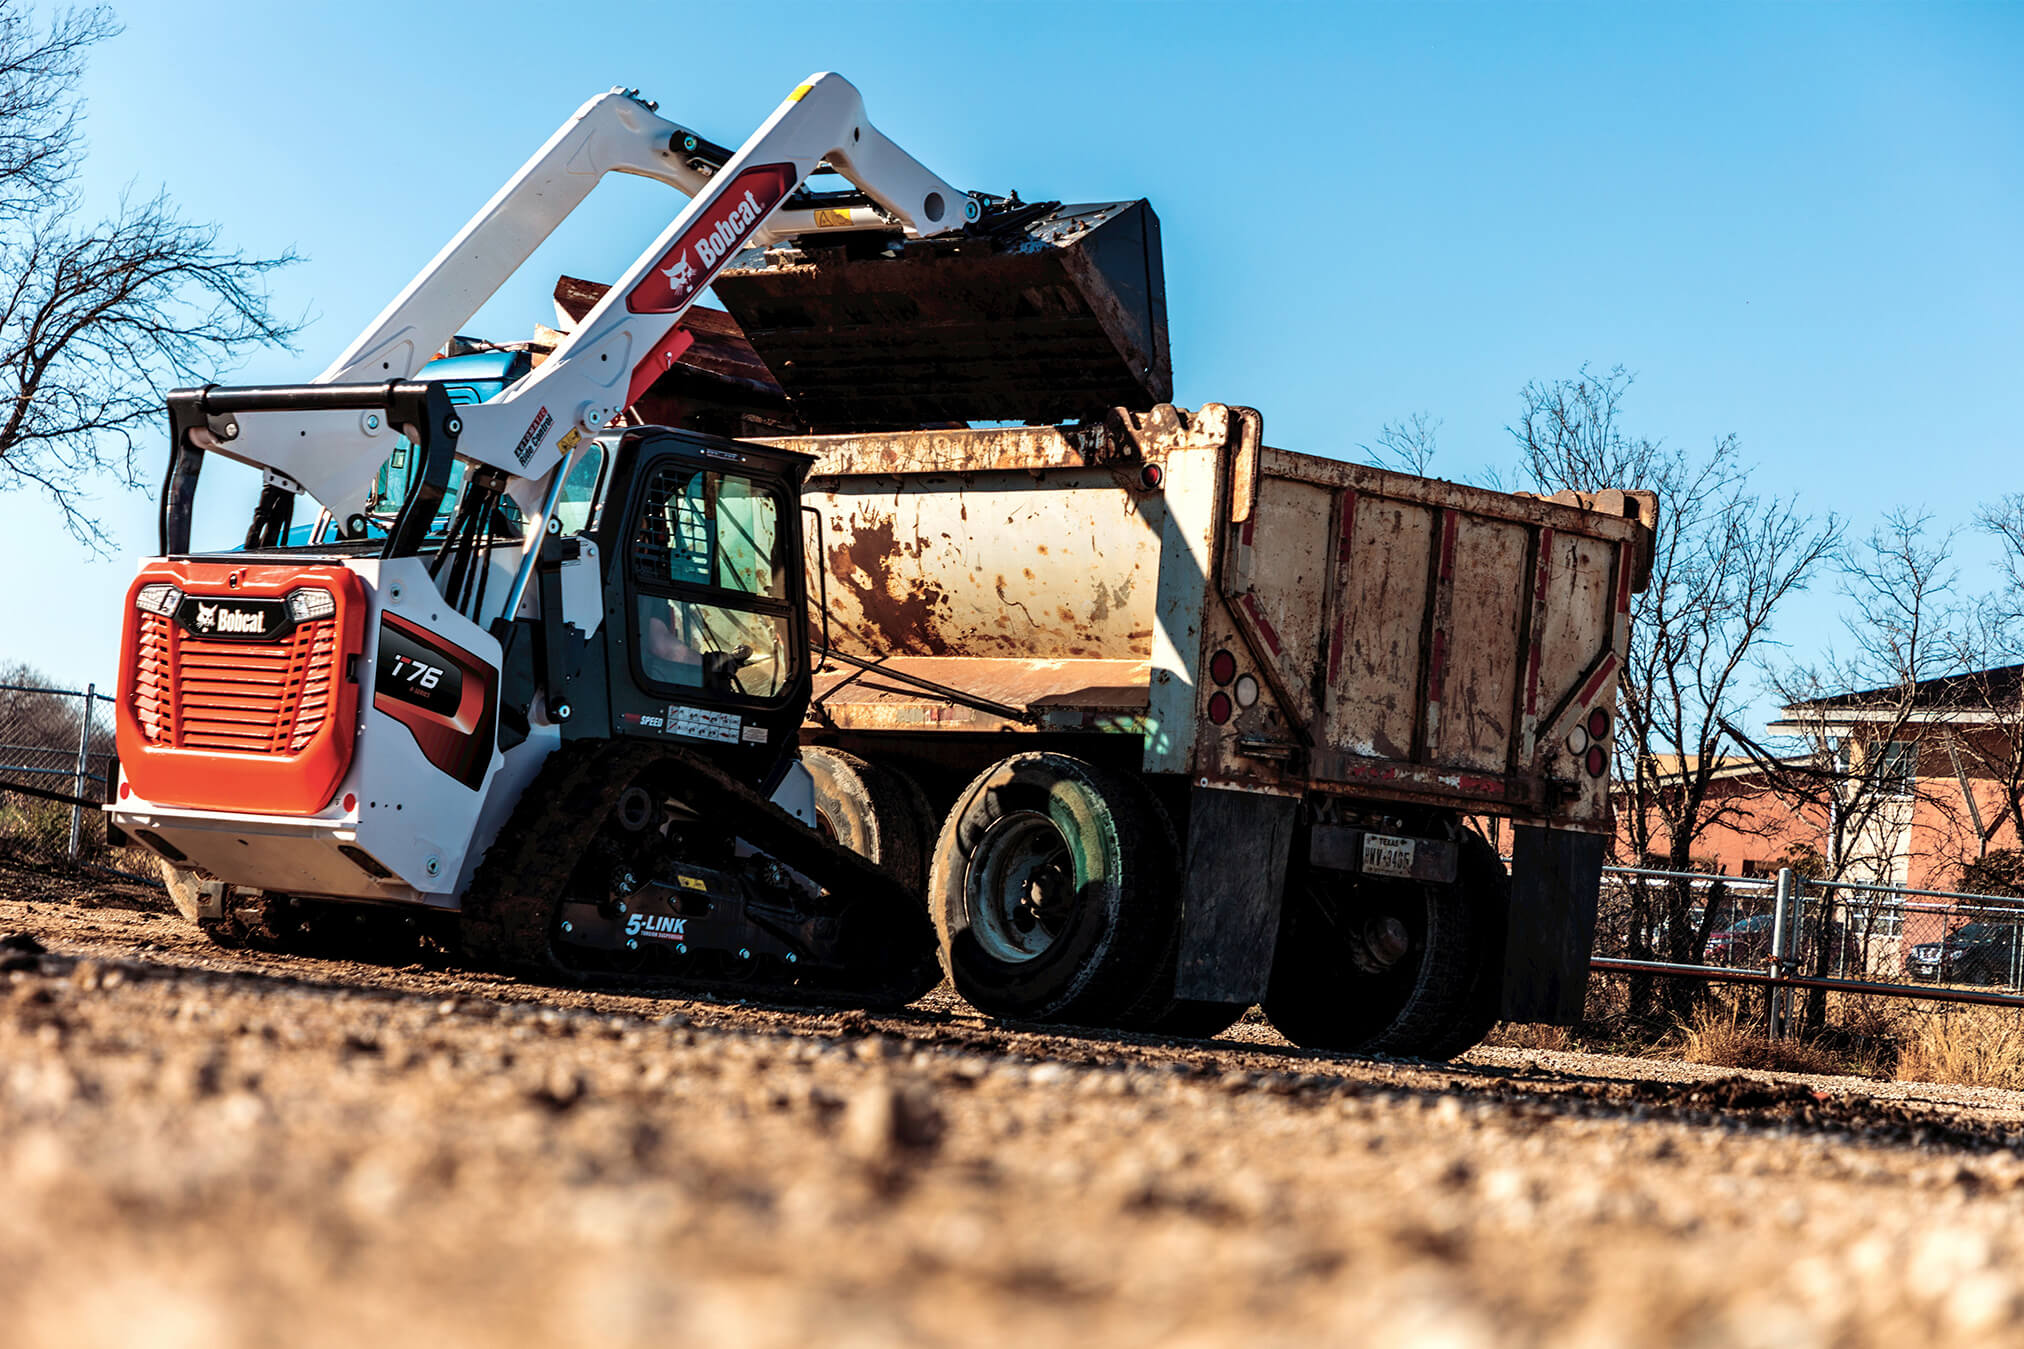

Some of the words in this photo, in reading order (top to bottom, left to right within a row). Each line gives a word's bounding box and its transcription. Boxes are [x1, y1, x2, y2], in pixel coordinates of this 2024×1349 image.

[694, 190, 762, 269] Bobcat
[519, 445, 534, 467] Ride
[531, 413, 553, 447] Control
[217, 608, 265, 633] Bobcat
[640, 715, 663, 728] SPEED
[1379, 837, 1399, 848] TEXAS
[625, 913, 688, 935] 5-LINK
